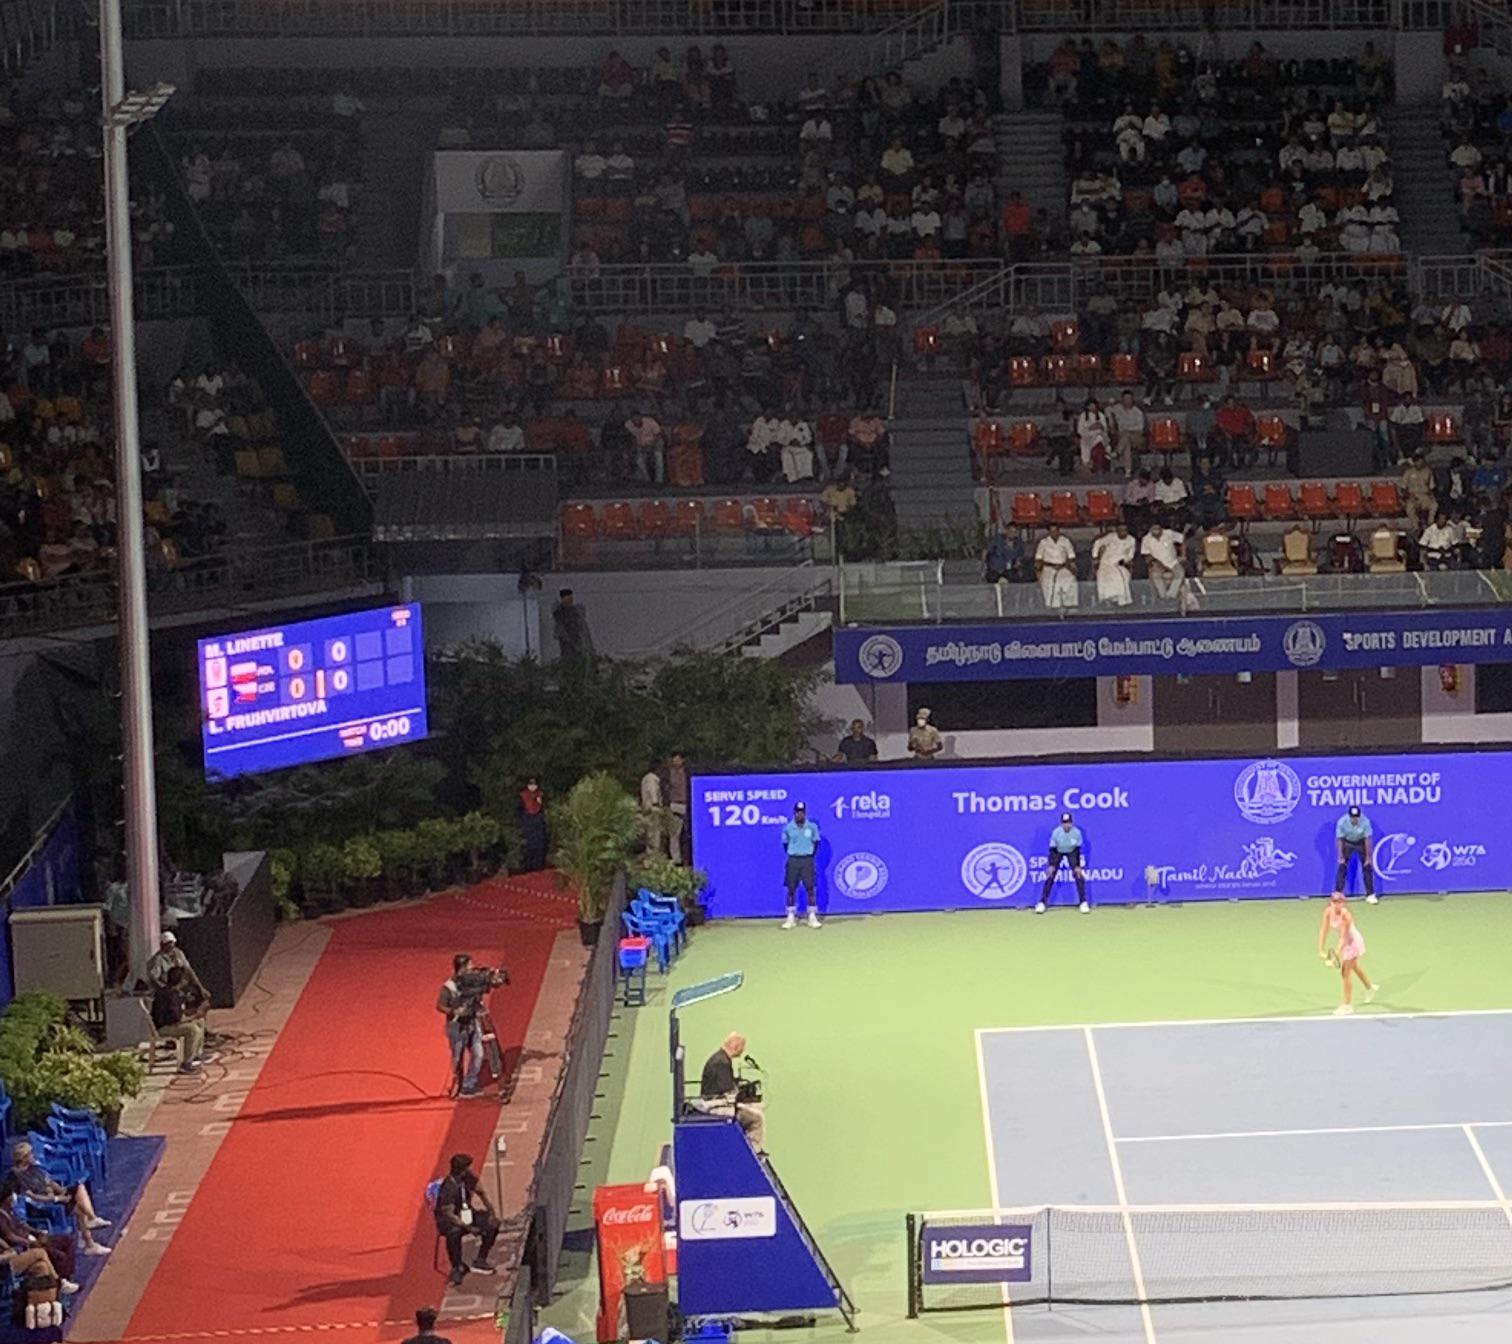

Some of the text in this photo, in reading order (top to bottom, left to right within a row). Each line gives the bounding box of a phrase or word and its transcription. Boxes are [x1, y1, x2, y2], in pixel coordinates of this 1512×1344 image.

[205, 632, 284, 659] M. LINETTE
[1343, 632, 1395, 650] SPORTS
[1403, 628, 1496, 649] DEVELOPMENT
[288, 649, 303, 671] 0
[331, 641, 347, 662] 0
[290, 678, 305, 699] 0
[332, 669, 348, 691] 0
[208, 699, 327, 735] L. FRUHVIRTOVA
[369, 717, 410, 741] 0:00
[1306, 772, 1441, 789] GOVERNMENT OF
[704, 789, 788, 803] SERVE SPEED
[851, 790, 891, 811] rela
[952, 786, 1130, 814] Thomas Cook
[1307, 786, 1441, 806] TAMIL NADU
[708, 804, 760, 827] 120
[1452, 844, 1487, 856] WTA
[1157, 859, 1260, 889] Tamil Nadu
[602, 1204, 655, 1226] Coca-Cola
[931, 1238, 1027, 1258] HOLOGIC
